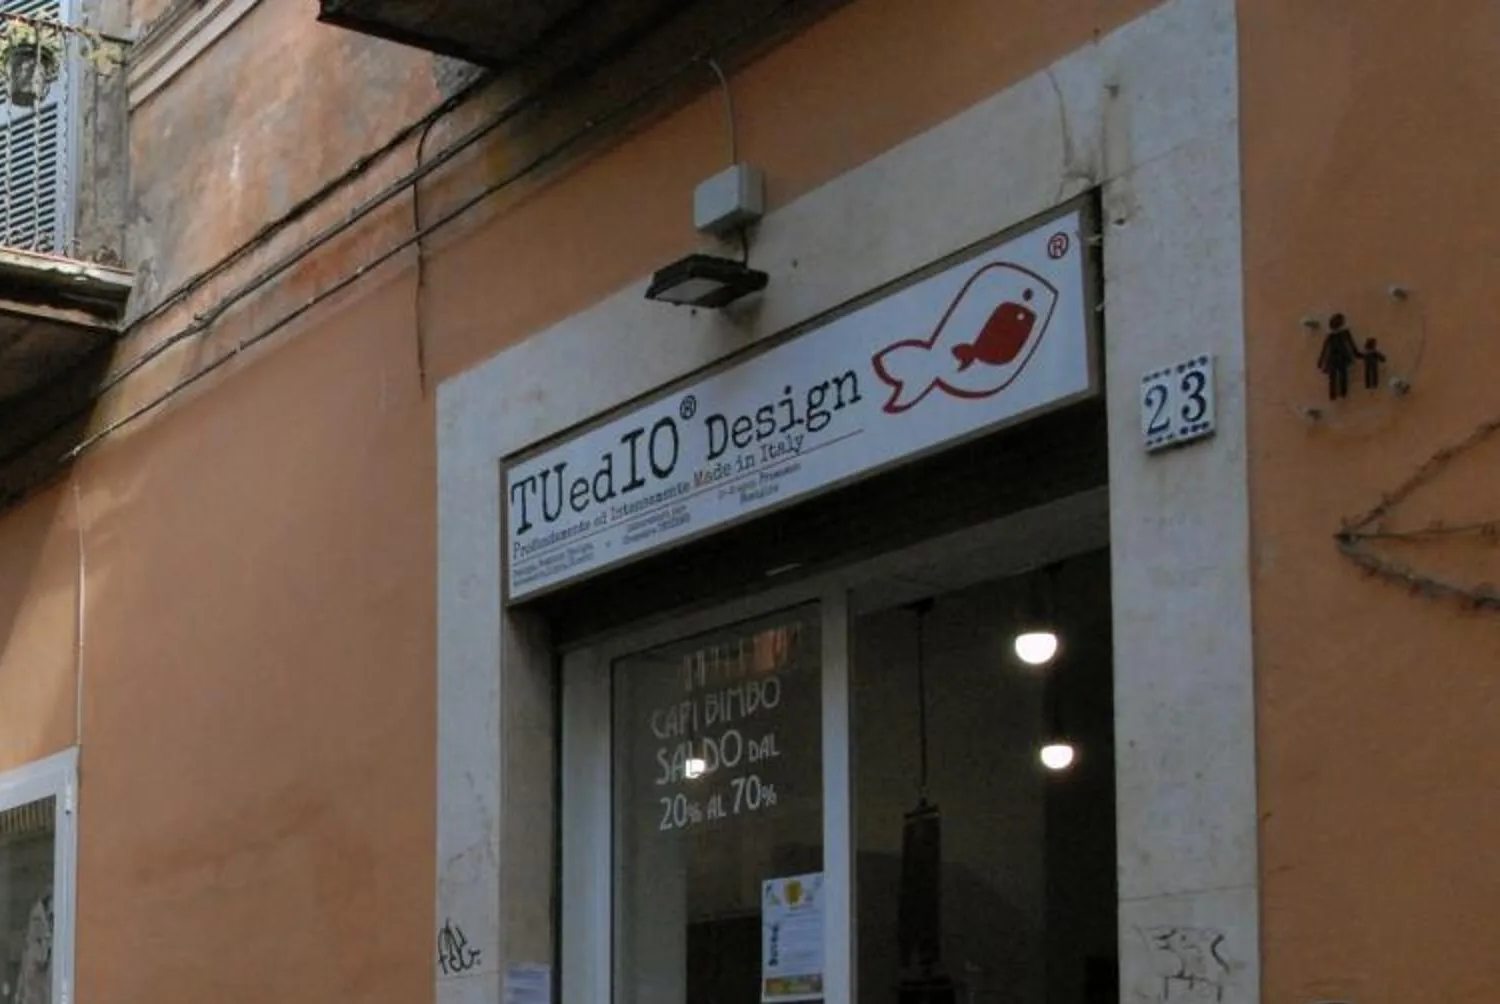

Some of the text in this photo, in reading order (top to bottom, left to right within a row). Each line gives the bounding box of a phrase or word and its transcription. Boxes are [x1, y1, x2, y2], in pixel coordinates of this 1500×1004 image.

[705, 369, 863, 461] Design
[1144, 370, 1207, 436] 23
[693, 463, 732, 487] Made
[735, 453, 755, 472] in
[760, 434, 805, 462] Italy
[651, 676, 781, 738] CAPI BIMBO
[655, 729, 781, 786] SALDO DAL
[659, 775, 778, 831] 20% AL 70%
